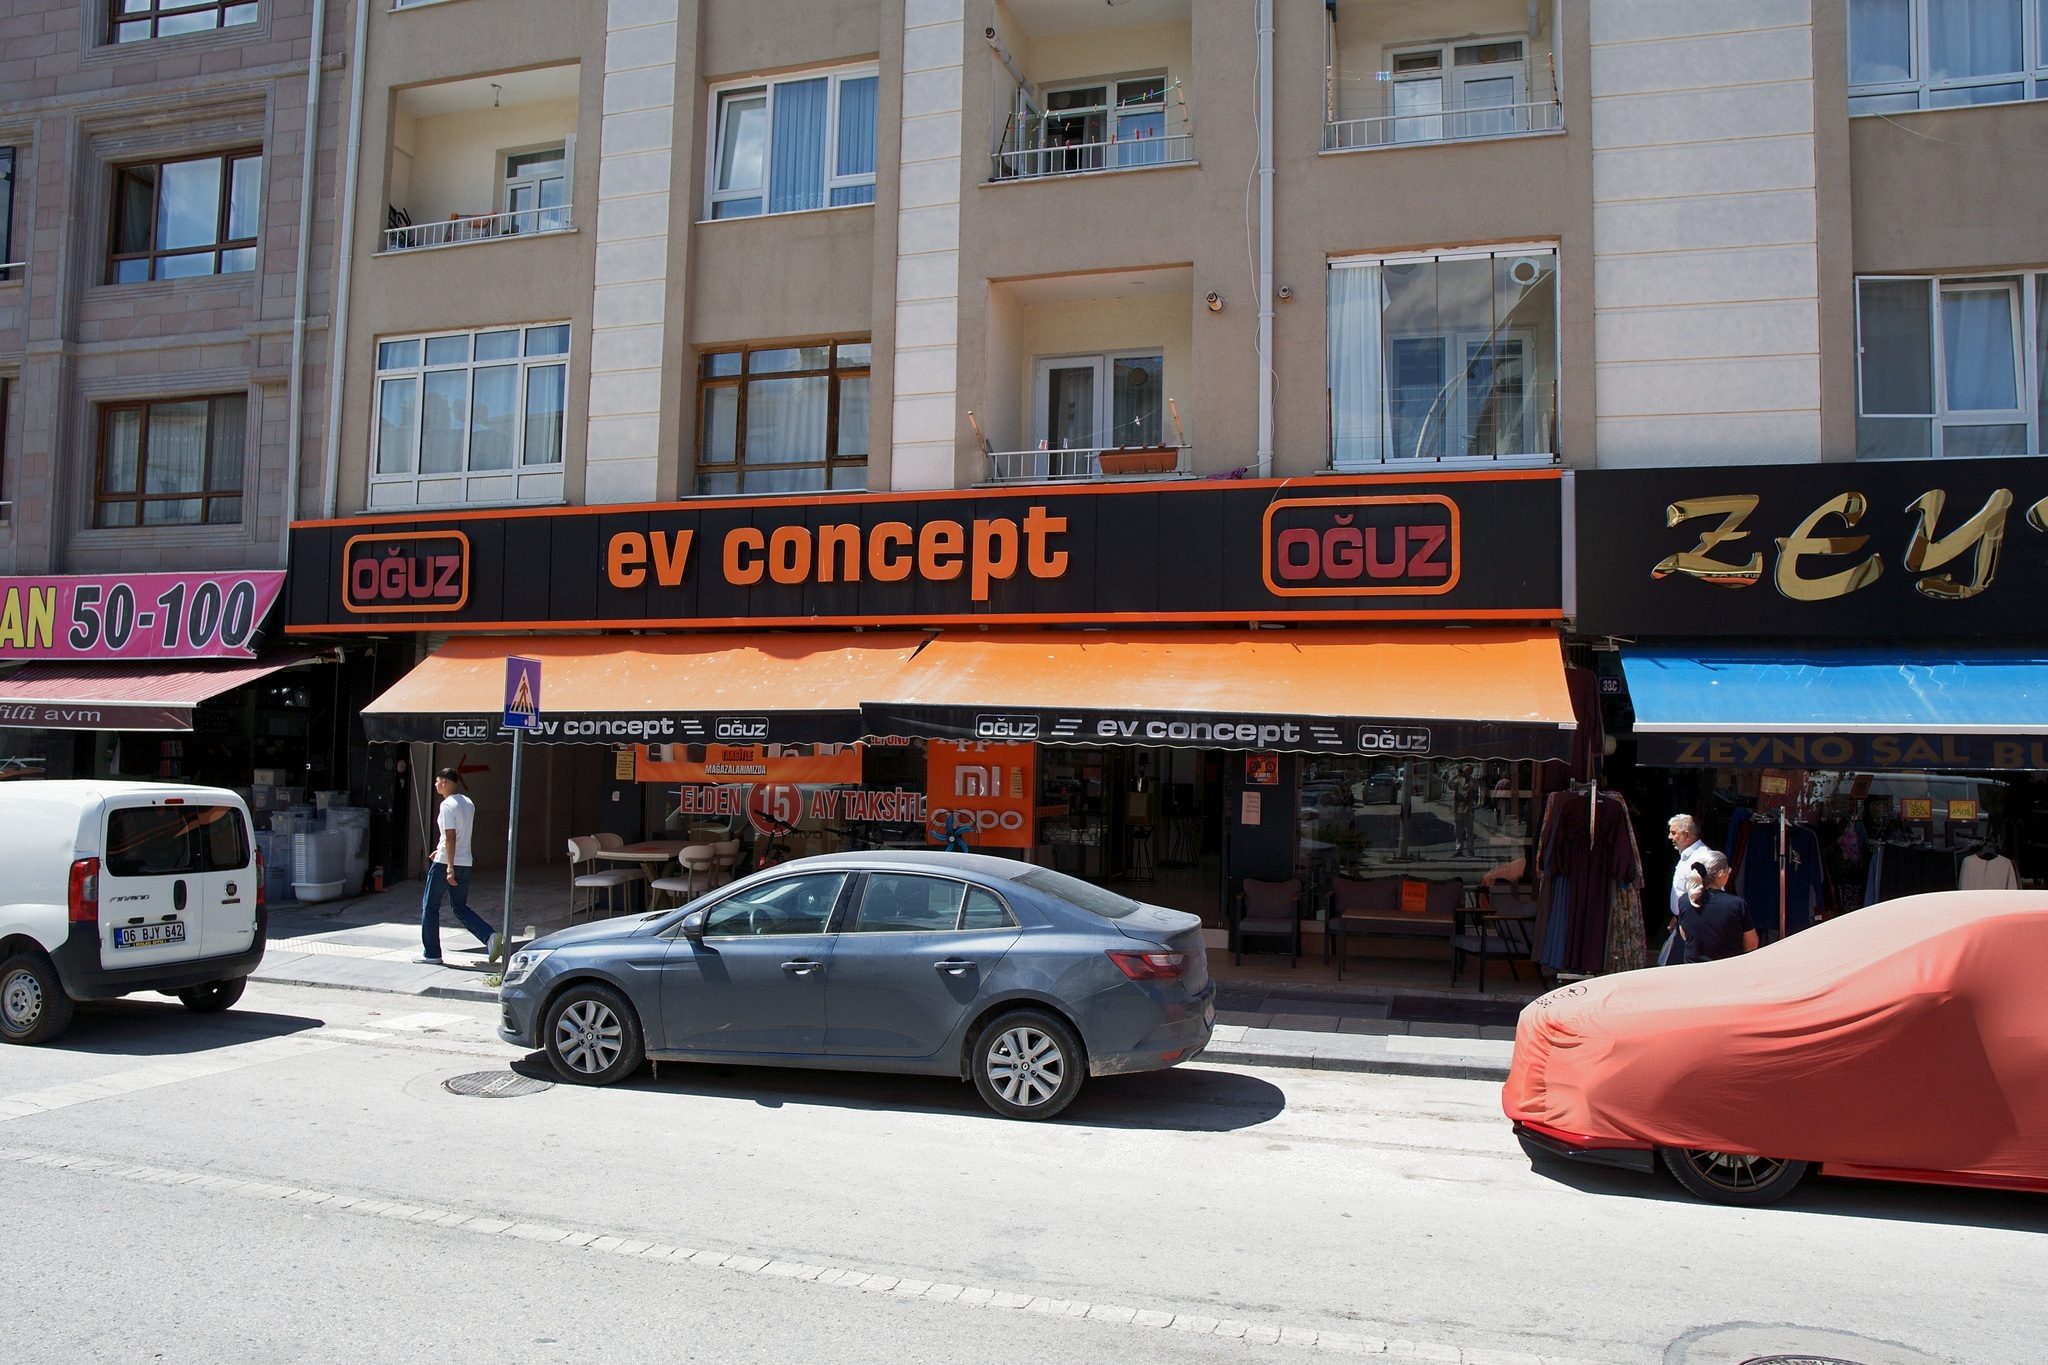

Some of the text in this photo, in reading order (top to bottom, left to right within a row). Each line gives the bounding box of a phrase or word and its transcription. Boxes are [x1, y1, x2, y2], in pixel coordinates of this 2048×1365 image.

[607, 506, 1069, 601] ev concept
[1277, 513, 1447, 580] OĞUZ
[1651, 488, 2048, 601] ZEY
[351, 547, 460, 600] OĞUZ
[68, 580, 256, 650] 50-100
[44, 709, 101, 722] avm
[446, 720, 486, 737] OĞUZ
[563, 718, 674, 739] concept
[718, 720, 767, 737] OĞUZ
[979, 718, 1428, 750] OĞUZ ev concept OĞUZ
[1676, 736, 1854, 763] ZEYNO
[1872, 736, 1970, 766] ŞAL
[681, 785, 742, 816] ELDEN
[760, 785, 791, 824] 15
[810, 790, 840, 819] AY
[123, 924, 182, 942] 06 BJY 642
